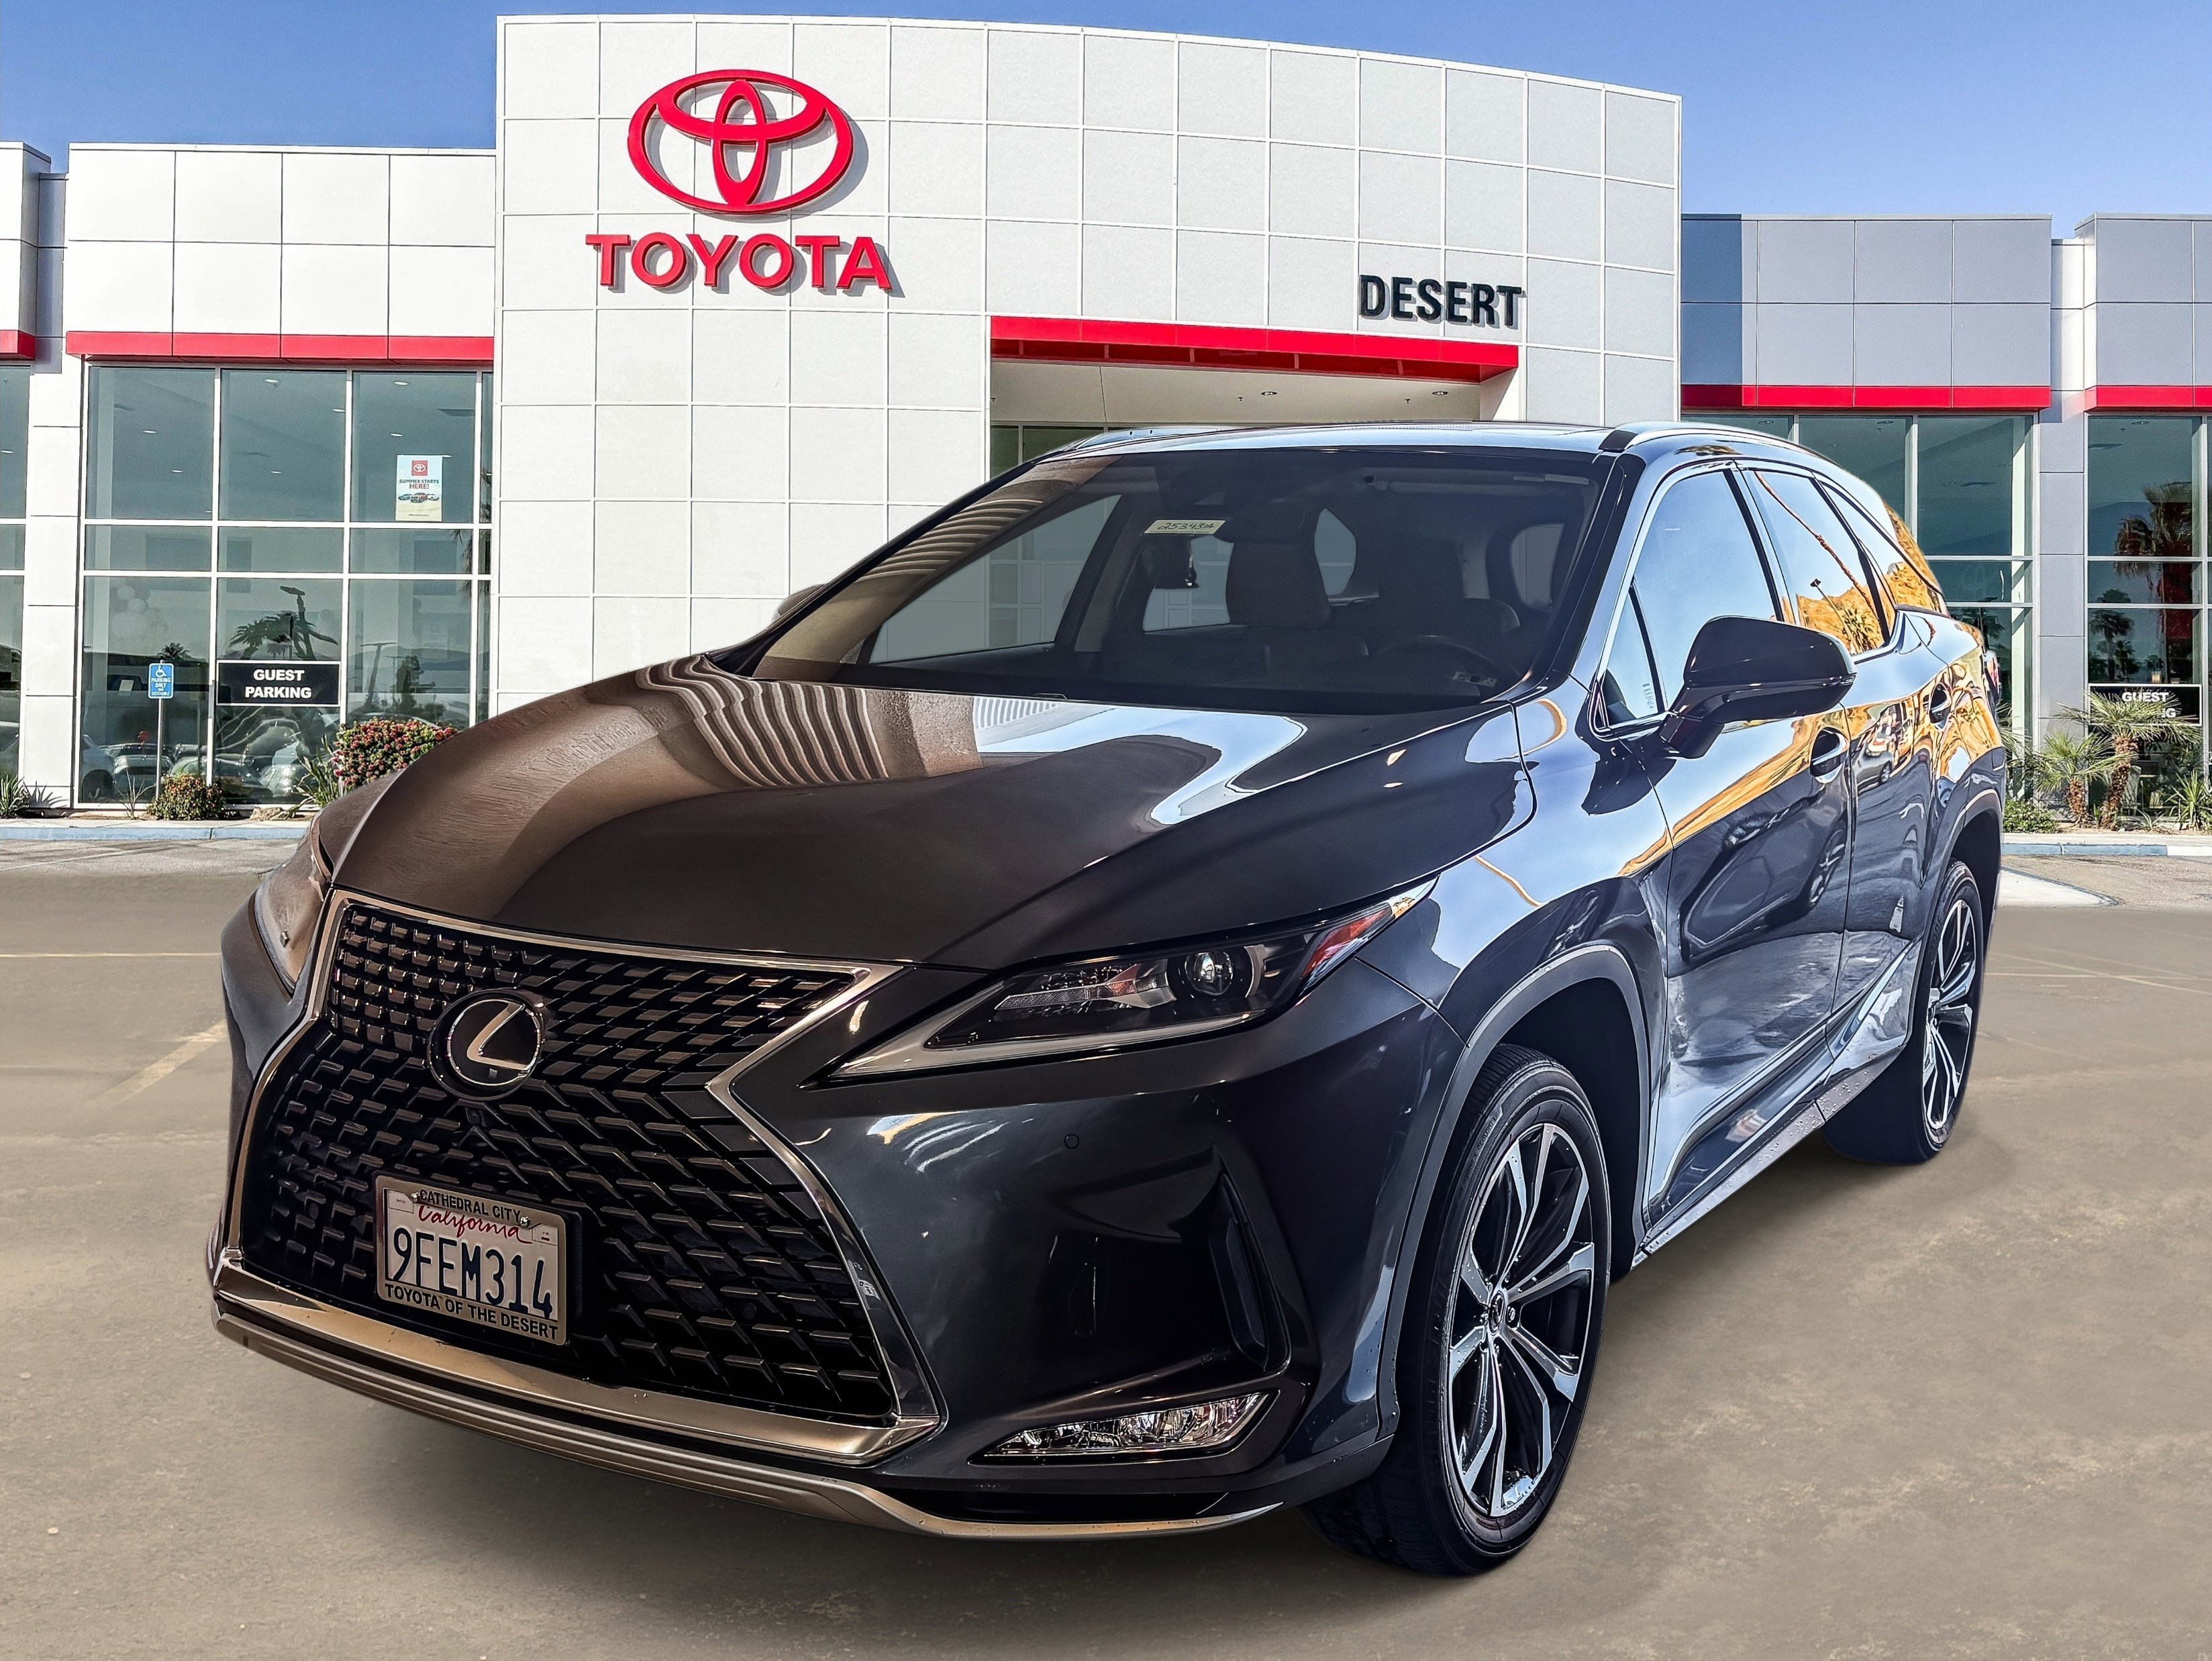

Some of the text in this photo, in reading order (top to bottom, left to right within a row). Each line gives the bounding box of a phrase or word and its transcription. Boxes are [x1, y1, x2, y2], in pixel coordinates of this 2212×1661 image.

[585, 232, 893, 290] TOYOTA
[1359, 274, 1522, 327] DESERT
[245, 686, 312, 699] PARKING
[253, 669, 305, 681] GUEST
[2121, 692, 2170, 703] GUEST
[418, 1205, 533, 1244] California
[419, 1189, 521, 1222] CATHEDRAL CITY
[393, 1227, 554, 1319] 9FEM314
[385, 1283, 558, 1340] TOYOTA OF THE DESERT
